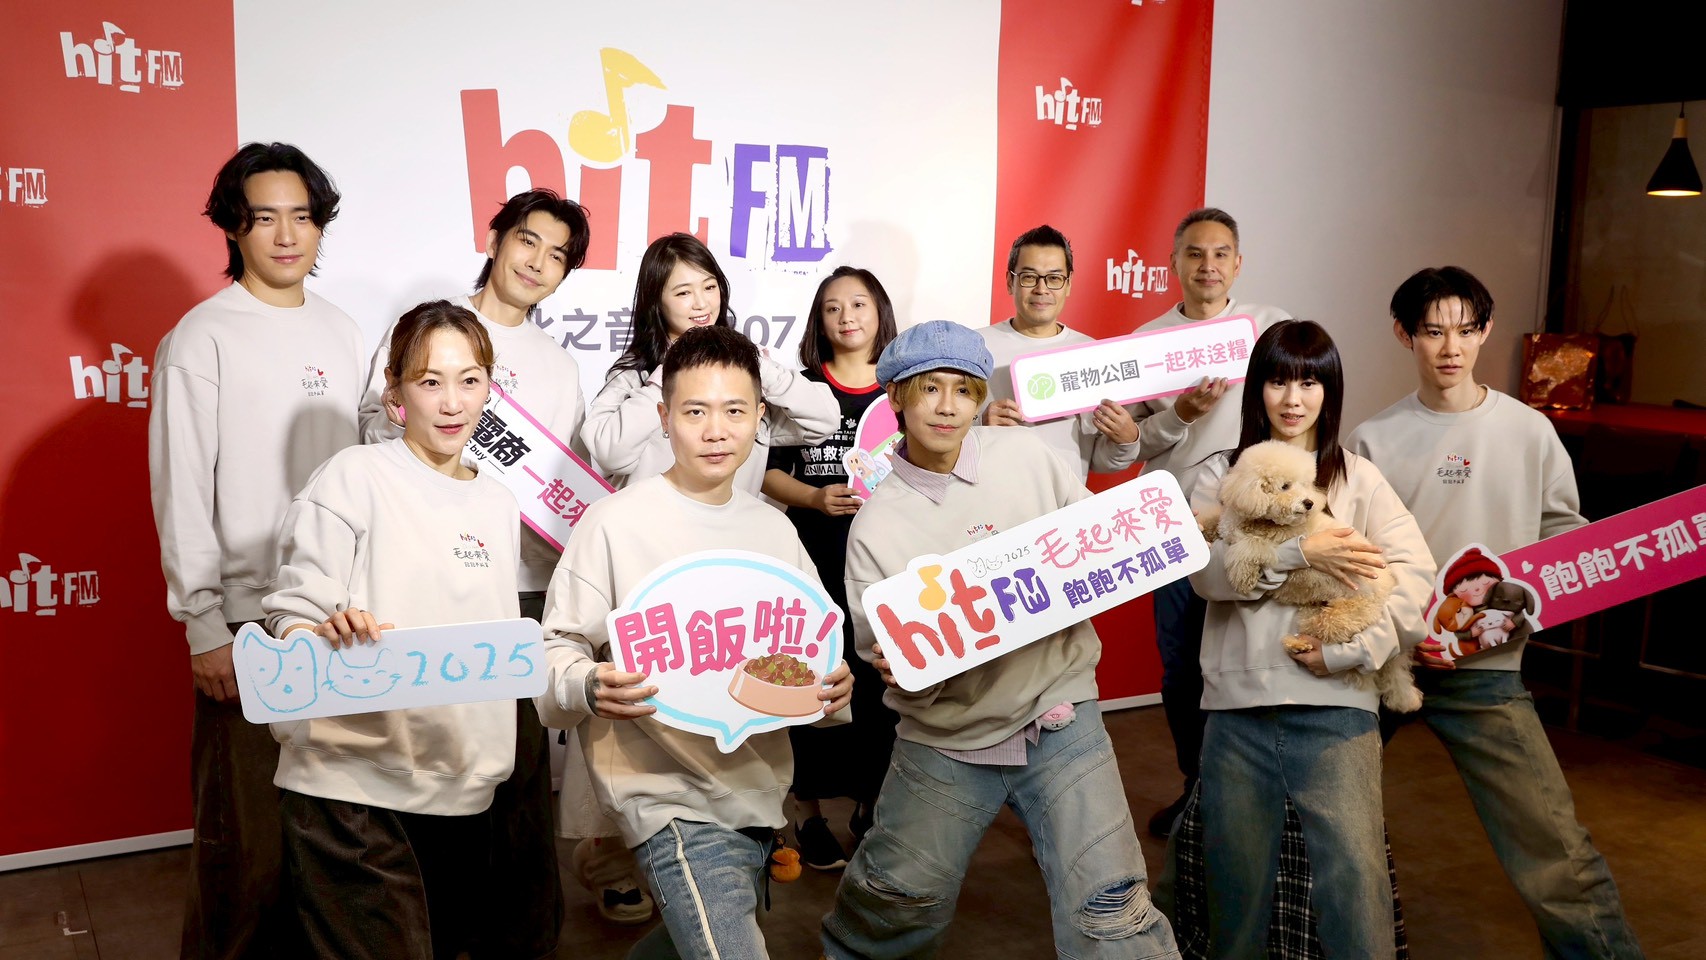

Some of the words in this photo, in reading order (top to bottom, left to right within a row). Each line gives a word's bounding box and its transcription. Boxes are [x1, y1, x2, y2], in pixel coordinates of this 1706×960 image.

[60, 21, 142, 93] hit
[146, 50, 184, 90] FM
[1035, 77, 1080, 130] hit
[1082, 97, 1102, 127] FM
[460, 47, 713, 270] hit
[726, 143, 834, 263] FM
[1106, 249, 1146, 298] hit
[1146, 266, 1168, 294] FM
[69, 343, 149, 408] hit
[1060, 359, 1141, 393] 寵物公園
[1144, 338, 1249, 374] 一起來送糧
[469, 443, 488, 461] buy
[472, 408, 532, 468] 電商
[805, 464, 839, 476] ANIMAL
[1004, 545, 1031, 564] 2025
[1034, 486, 1182, 569] 毛起來愛
[61, 571, 101, 607] FM
[1062, 536, 1189, 608] 飽飽不孤單
[614, 596, 838, 676] 開飯啦!
[876, 564, 1001, 670] hit
[406, 642, 537, 686] 2025
